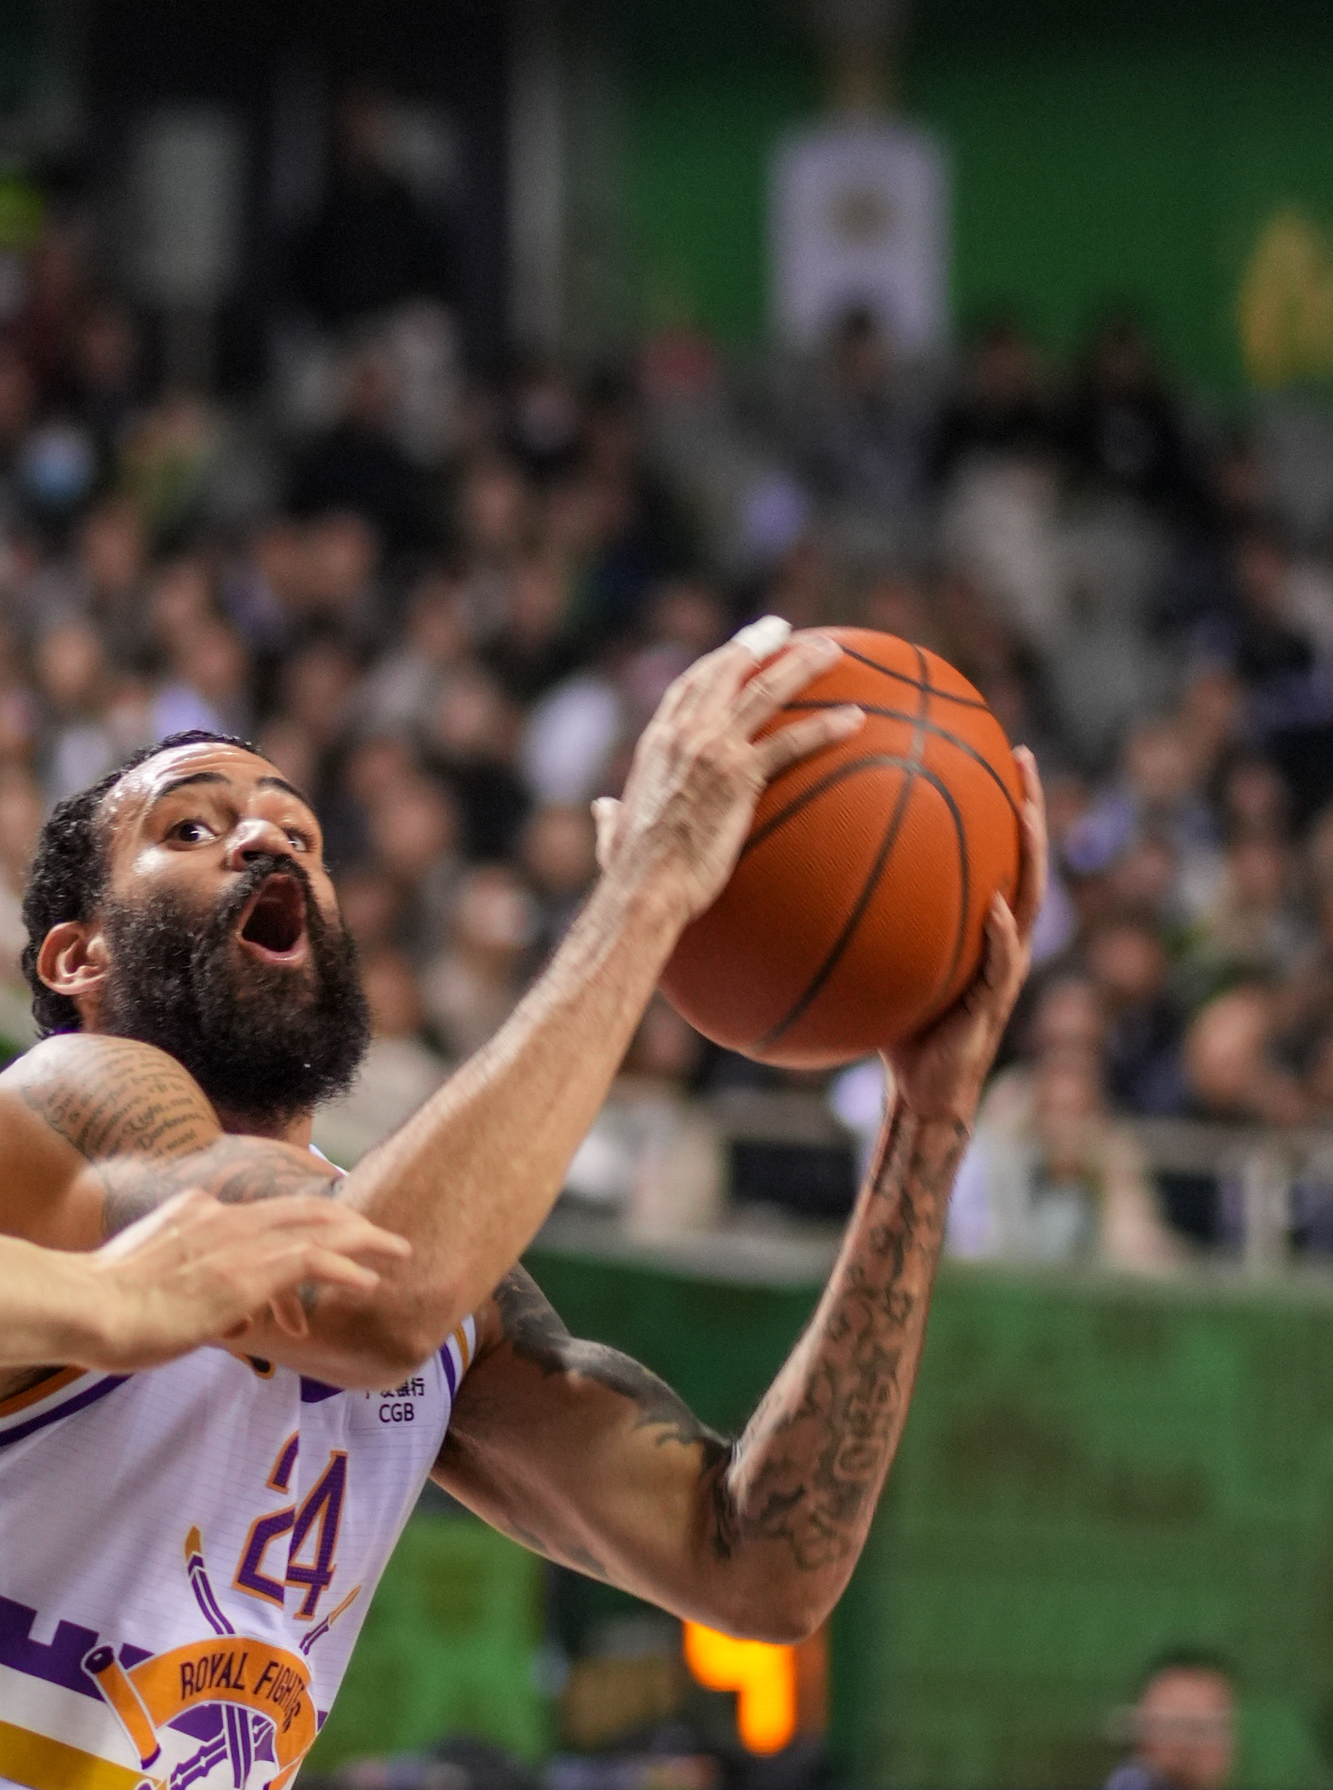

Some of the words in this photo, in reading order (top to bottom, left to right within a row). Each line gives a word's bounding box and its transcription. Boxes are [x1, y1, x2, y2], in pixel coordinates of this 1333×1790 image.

[378, 1402, 415, 1423] CGB
[232, 1430, 348, 1621] 24
[179, 1651, 248, 1701] ROYAL
